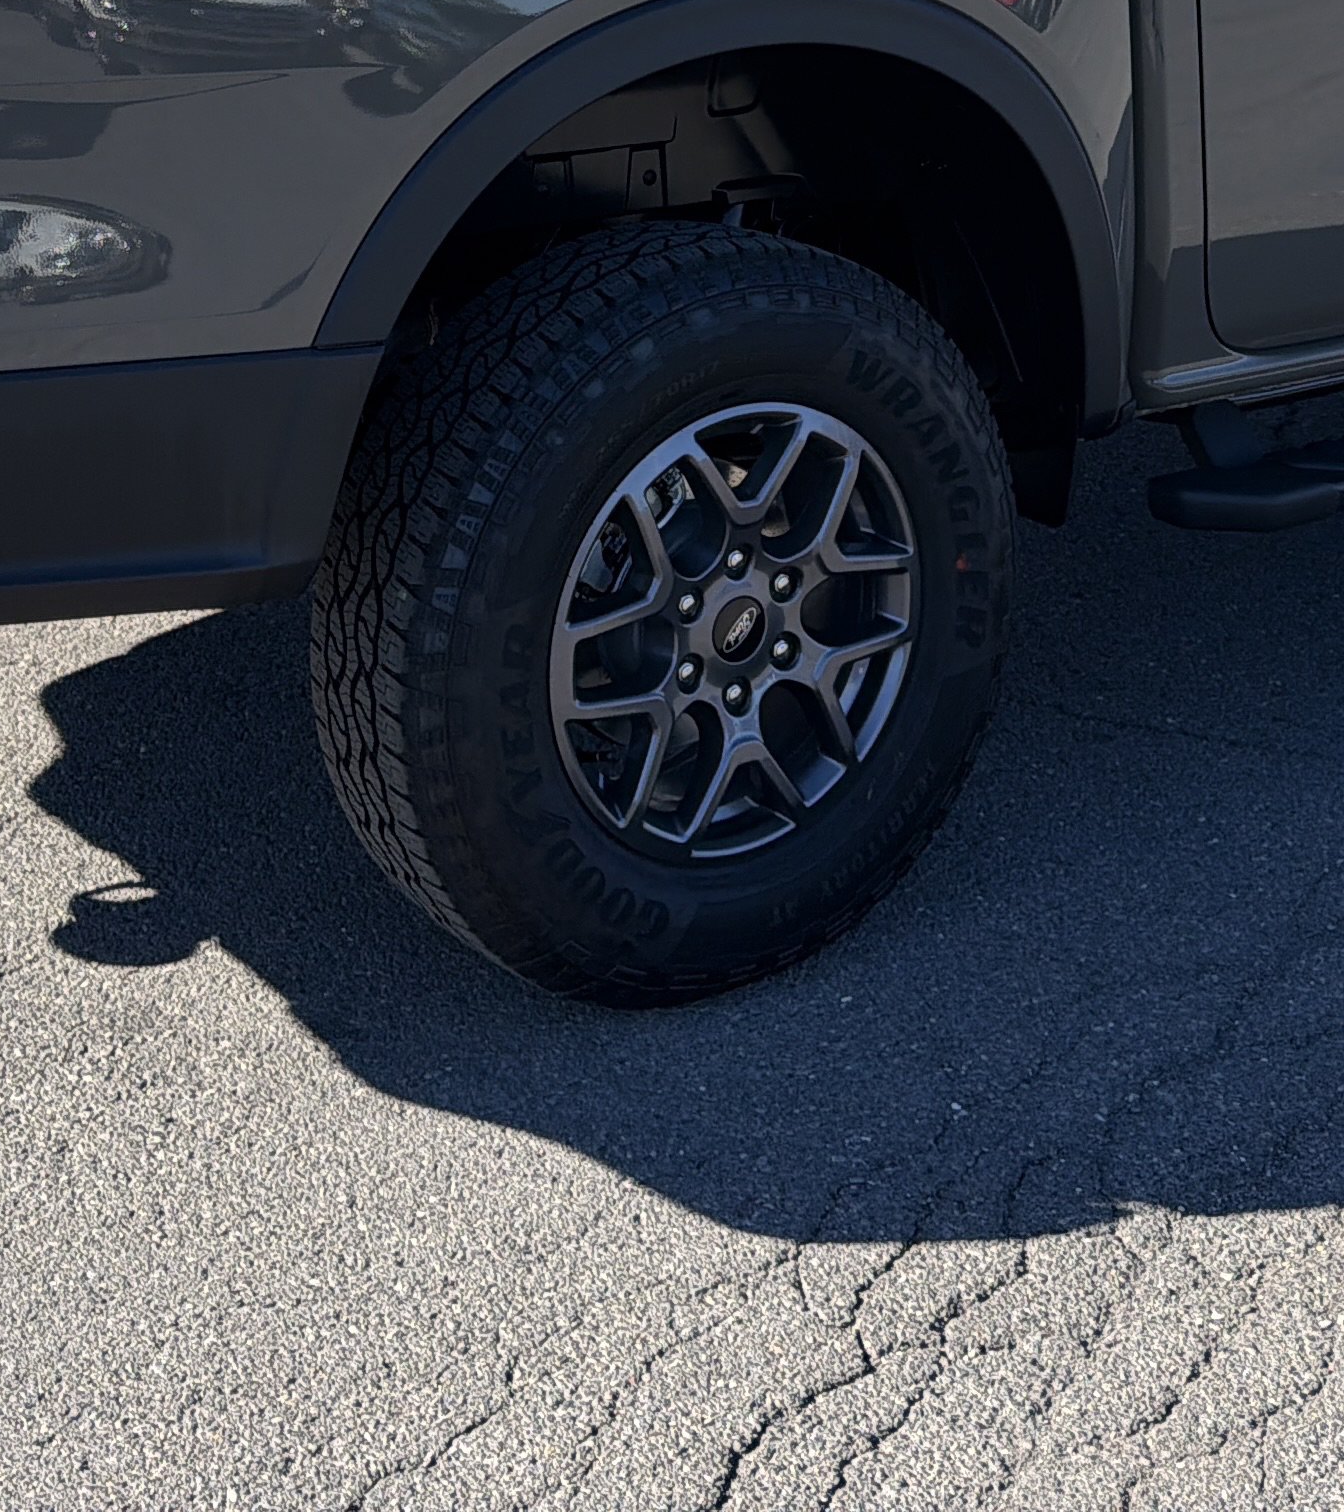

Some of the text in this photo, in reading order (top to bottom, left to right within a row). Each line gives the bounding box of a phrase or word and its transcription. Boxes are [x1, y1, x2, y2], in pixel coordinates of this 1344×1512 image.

[728, 612, 753, 647] Ford
[843, 346, 990, 652] WRANGLER
[497, 620, 672, 941] GOODYEAR
